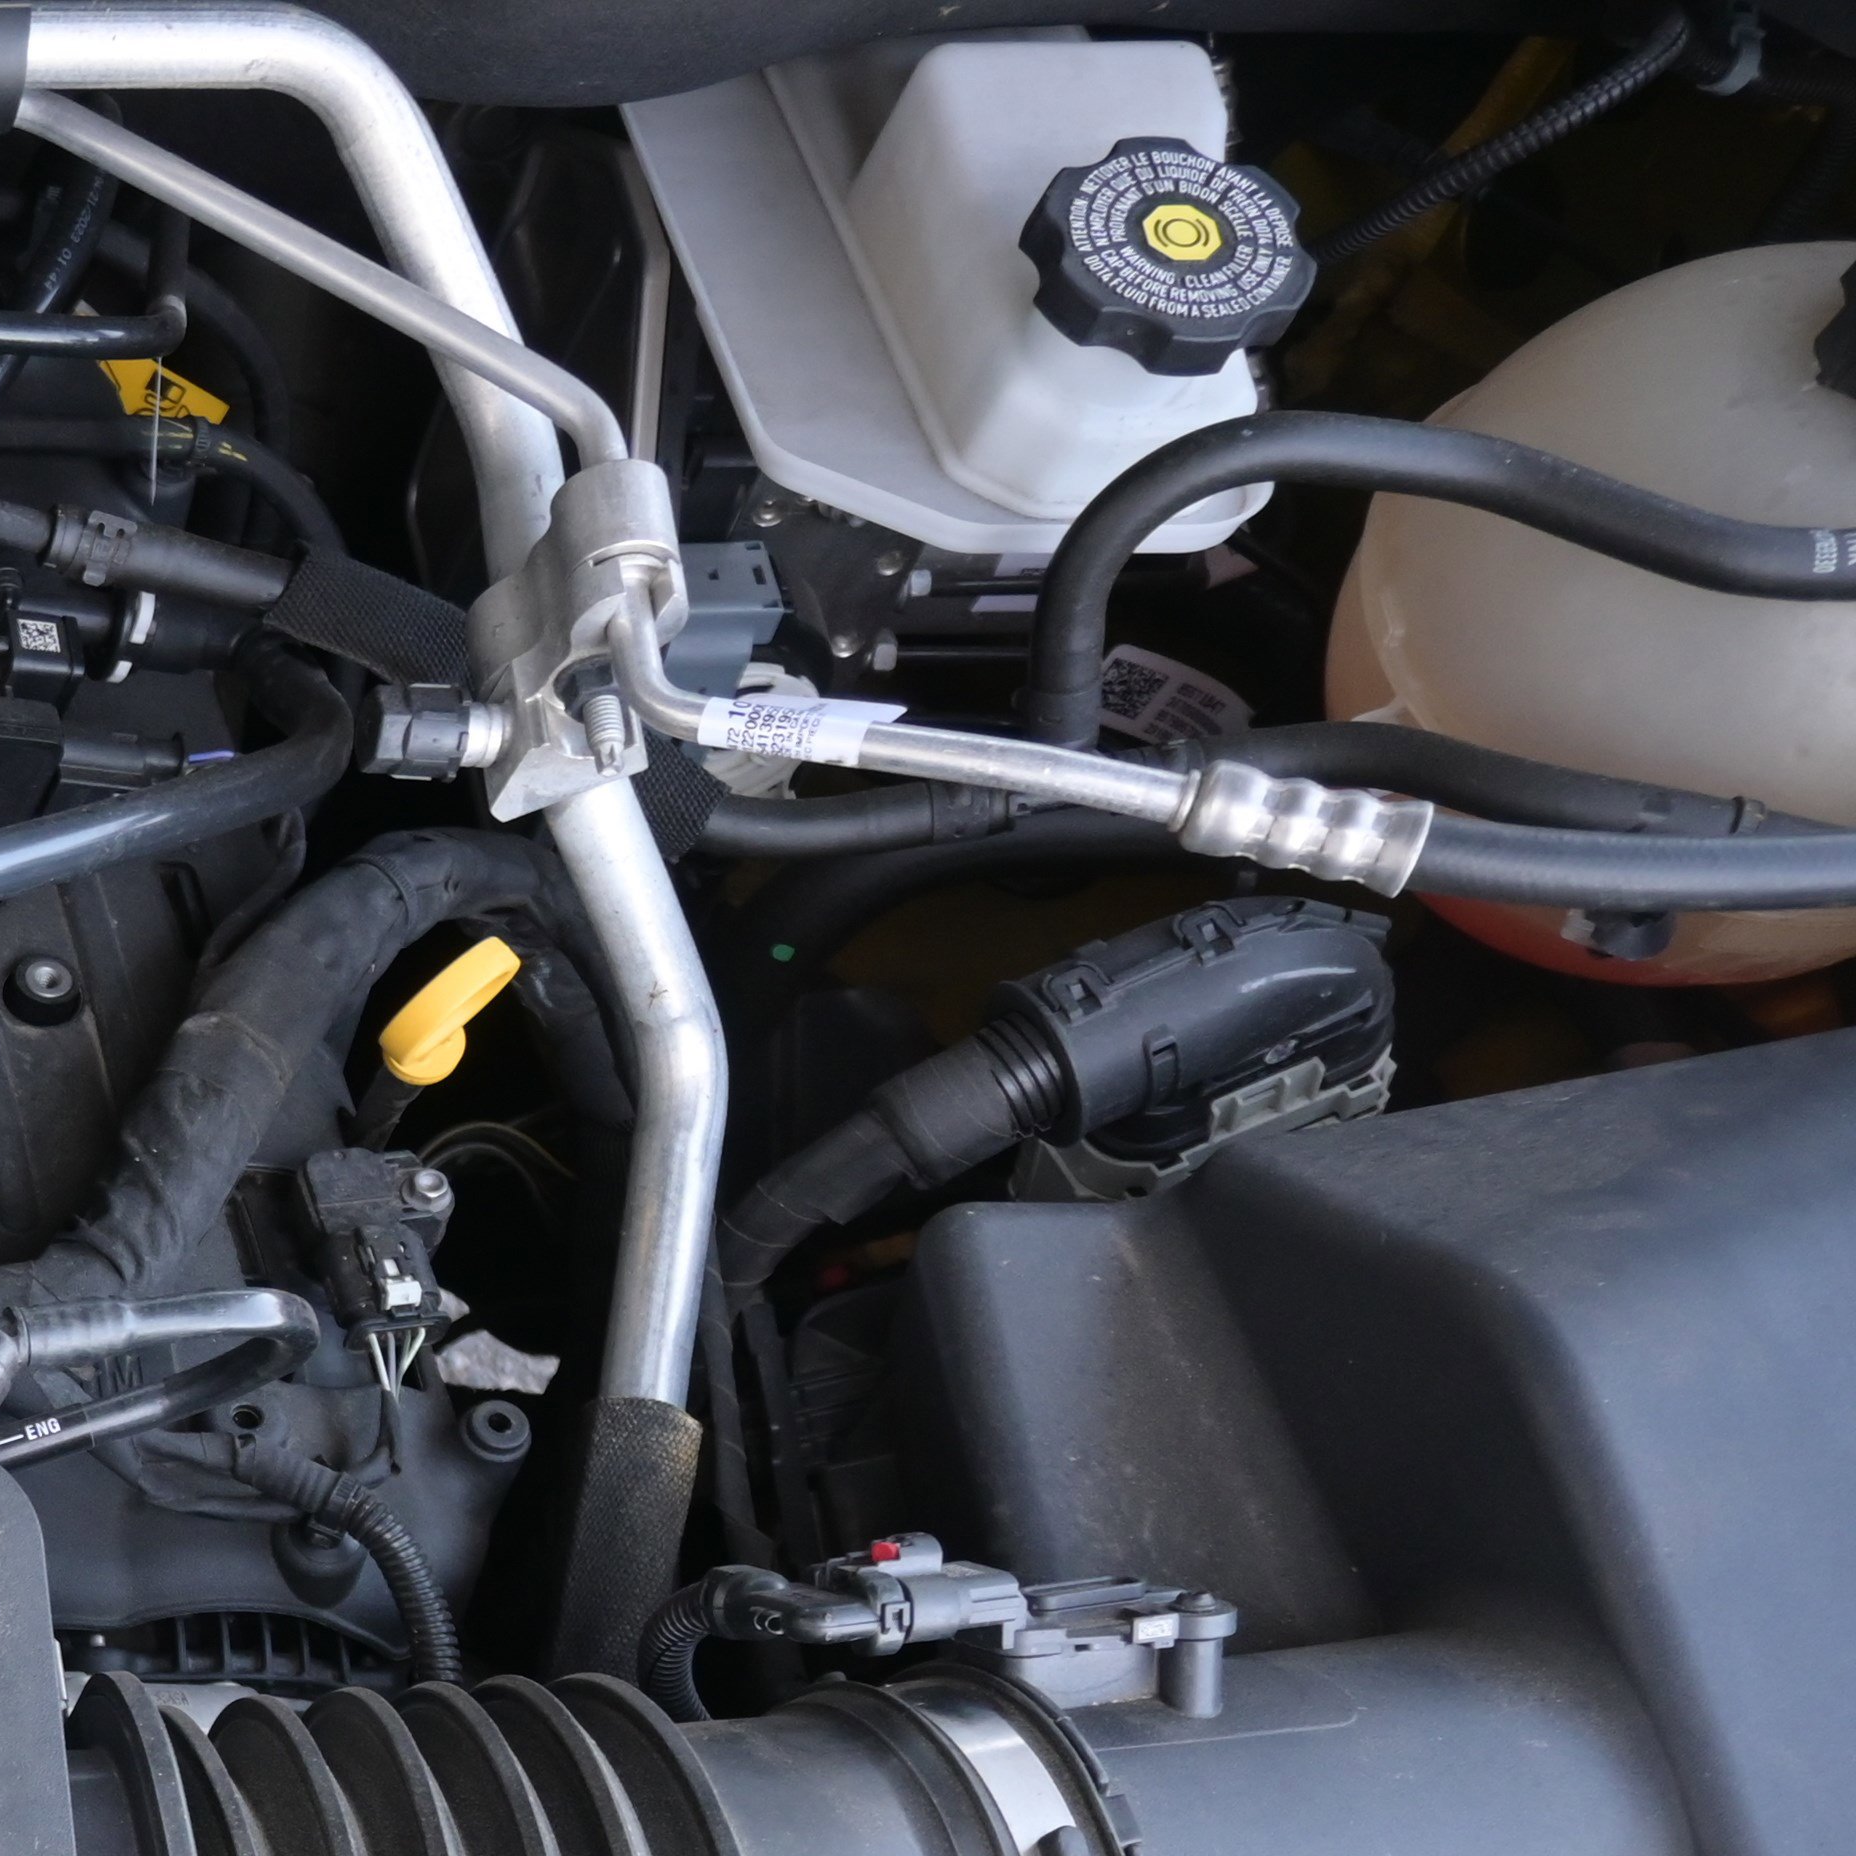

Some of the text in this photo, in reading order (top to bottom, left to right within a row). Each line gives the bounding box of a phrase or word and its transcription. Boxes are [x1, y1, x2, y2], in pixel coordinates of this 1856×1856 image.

[1079, 156, 1132, 195] NETTOYER
[1131, 151, 1150, 167] LE
[1151, 150, 1216, 174] BOUCHON
[1215, 165, 1260, 194] AVANT
[1252, 191, 1273, 209] LA
[1264, 207, 1294, 249] DEPOSE
[1109, 171, 1138, 191] QUE
[1134, 165, 1155, 181] DU
[1156, 164, 1209, 185] LIQUIDE
[1209, 176, 1230, 193] DE
[1227, 187, 1263, 219] FREIN
[1109, 179, 1255, 242] PROVENANT D'UN BIDON SCELLE
[1083, 254, 1115, 283] DOT4
[1108, 277, 1149, 305] FLUID
[1148, 295, 1189, 318] FROM
[1190, 303, 1201, 318] A
[1200, 296, 1252, 318] SEALED
[1100, 248, 1126, 269] CAP
[1118, 265, 1170, 298] BEFORE
[1236, 270, 1263, 291] USE
[1184, 270, 1229, 289] CLEAN
[1221, 244, 1255, 279] FILLER
[728, 701, 752, 718] 10
[24, 1417, 62, 1441] ENG
